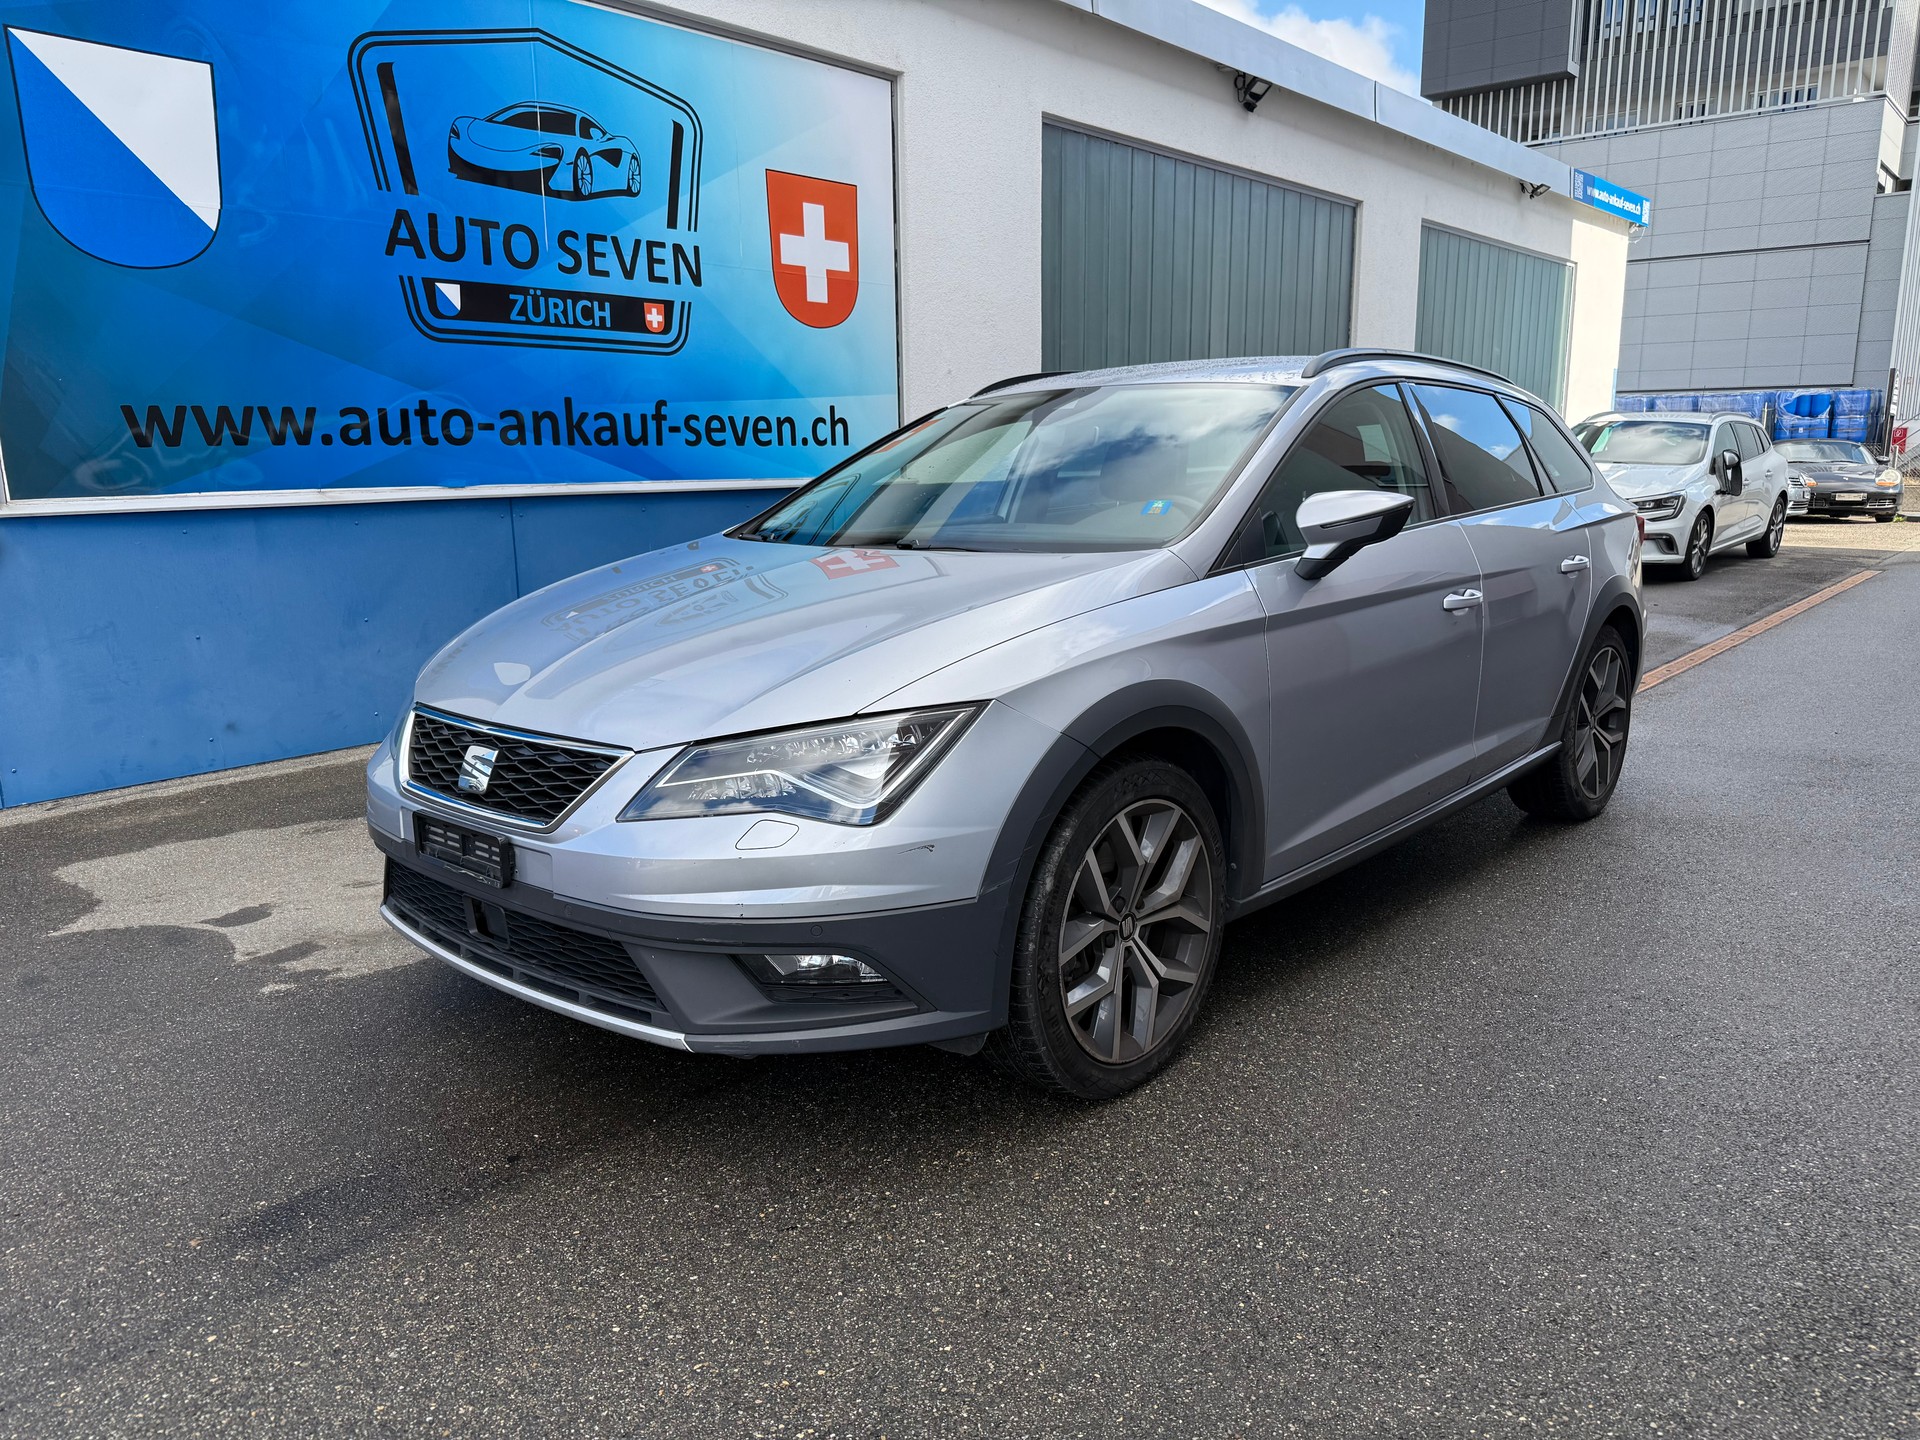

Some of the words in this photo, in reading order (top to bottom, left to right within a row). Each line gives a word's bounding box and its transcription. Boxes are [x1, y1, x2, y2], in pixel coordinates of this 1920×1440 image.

[385, 208, 540, 270] AUTO
[557, 229, 703, 287] SEVEN
[508, 288, 612, 328] ZÜRICH
[119, 396, 850, 448] www.auto-ankauf-seven.ch
